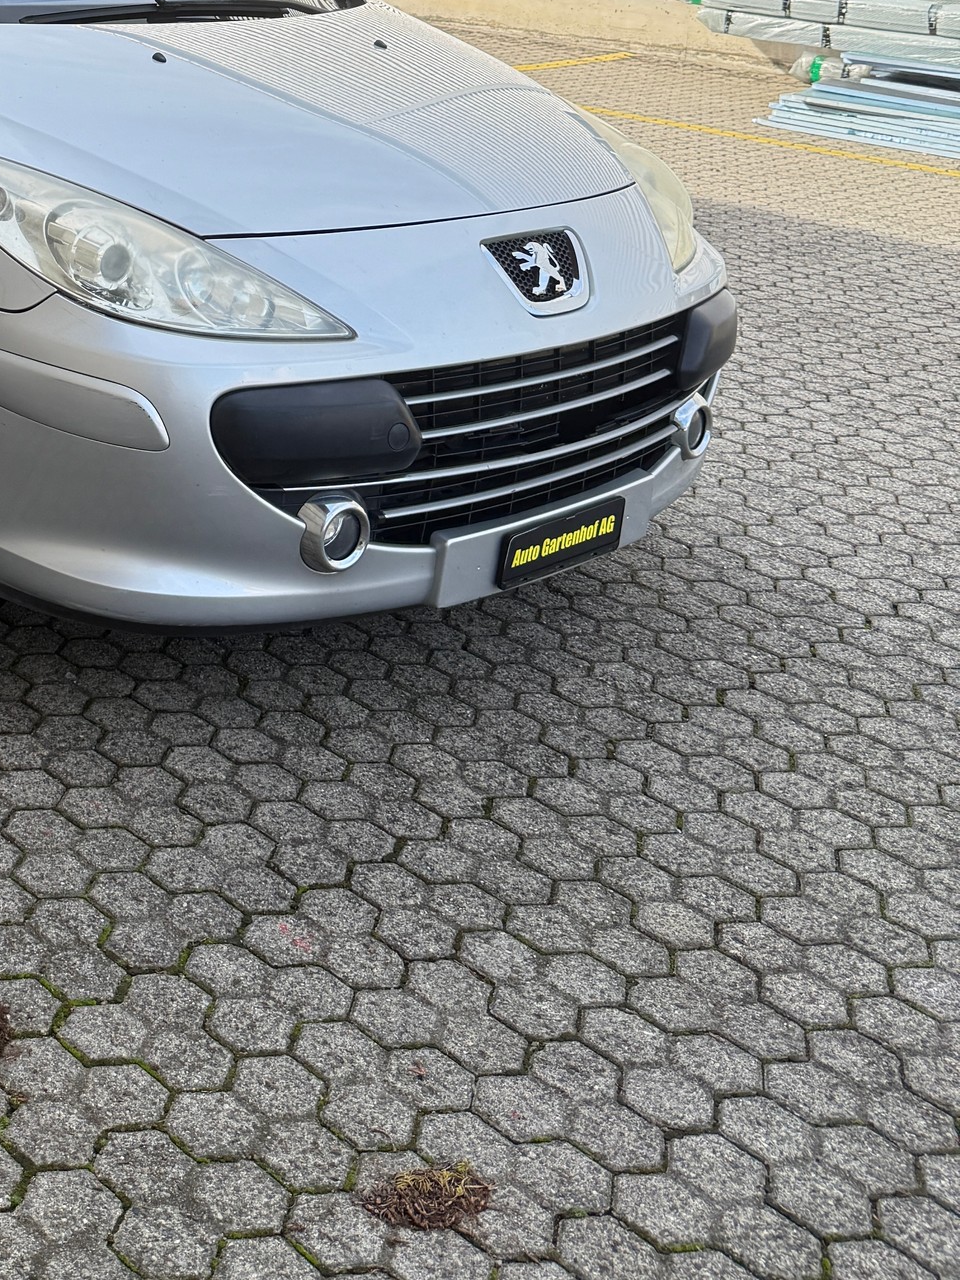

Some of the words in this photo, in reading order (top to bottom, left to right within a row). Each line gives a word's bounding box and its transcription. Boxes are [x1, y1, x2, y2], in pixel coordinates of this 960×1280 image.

[511, 545, 540, 568] Auto
[541, 520, 599, 557] Gartenhof
[598, 515, 615, 536] AG
